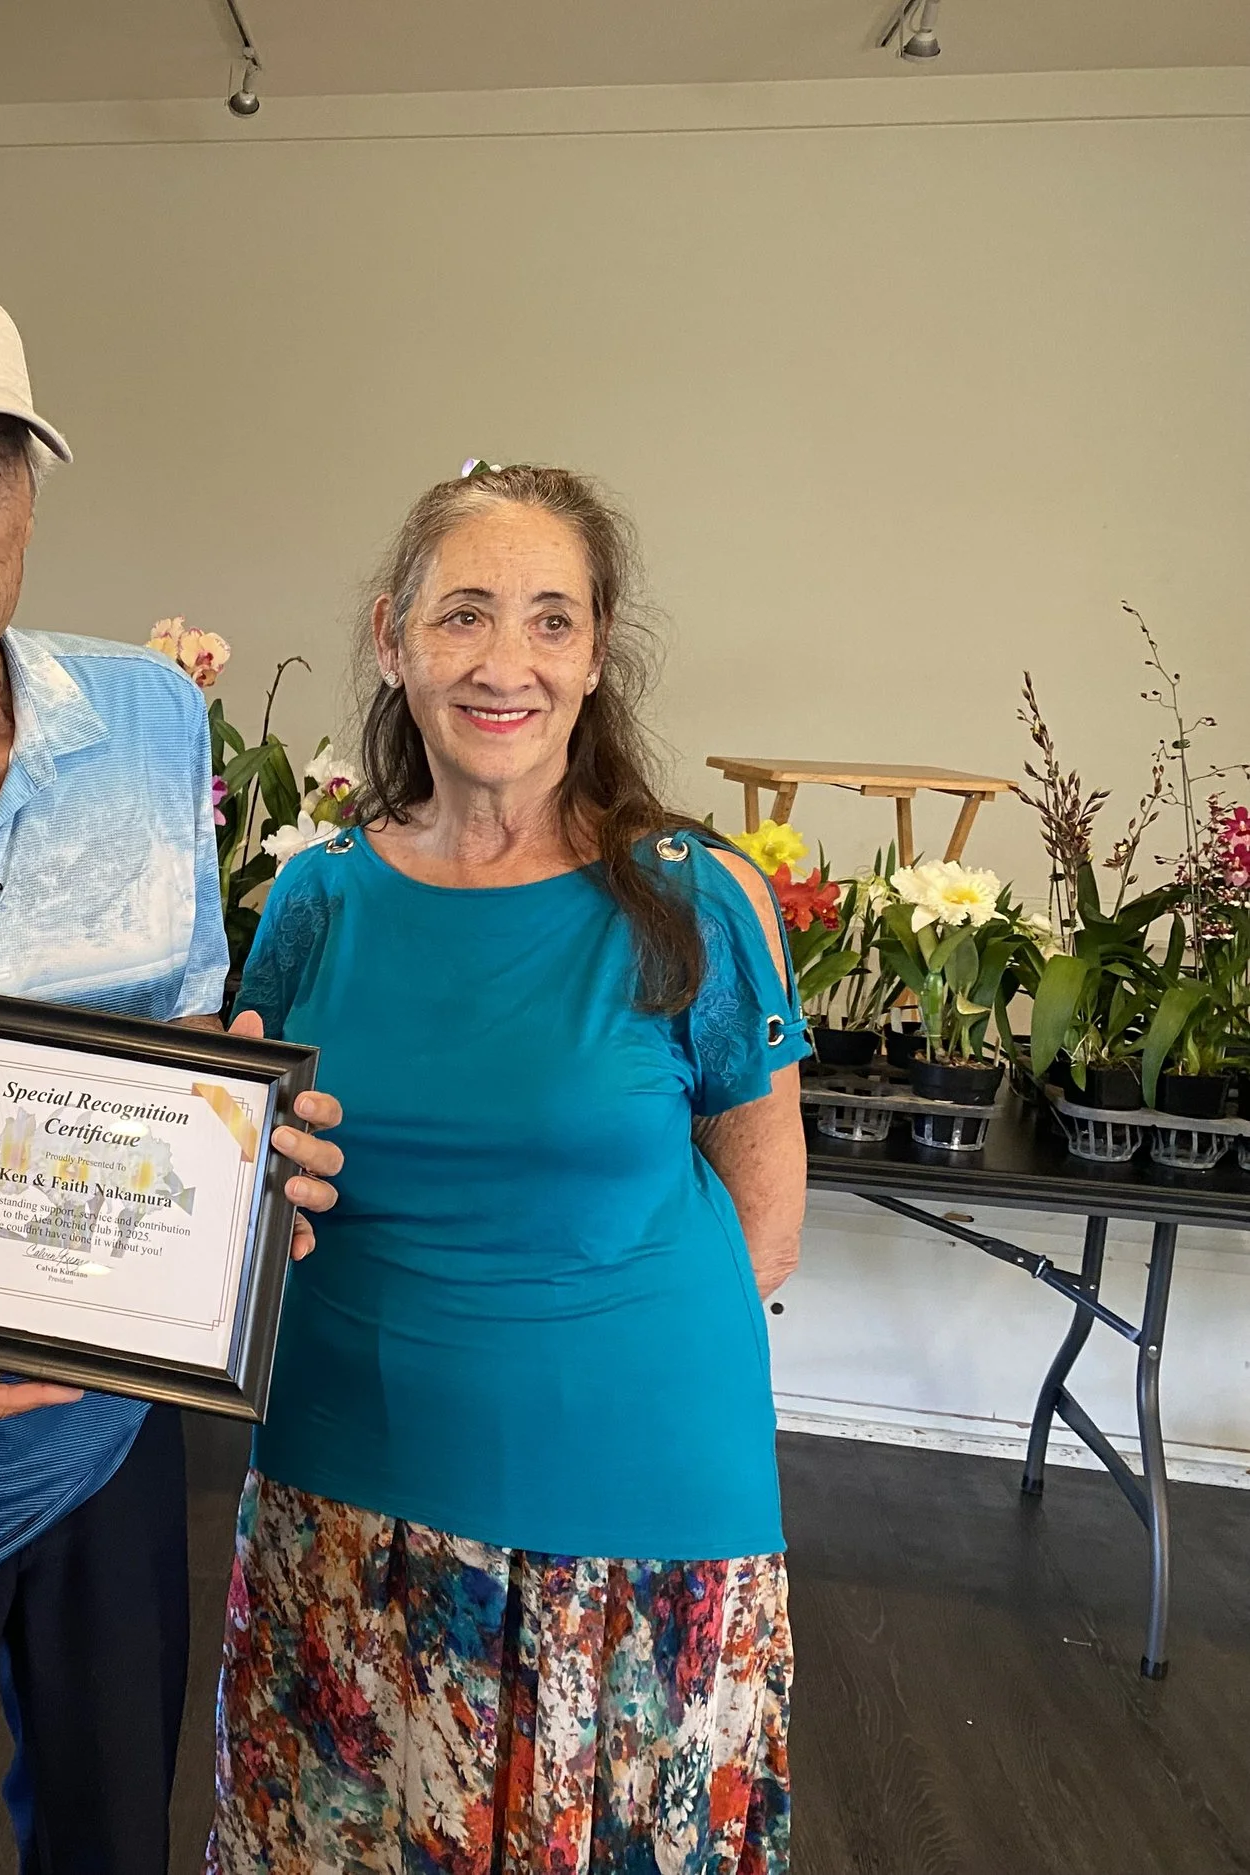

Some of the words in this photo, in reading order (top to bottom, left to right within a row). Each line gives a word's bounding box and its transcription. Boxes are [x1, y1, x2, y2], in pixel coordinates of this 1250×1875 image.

[2, 1081, 73, 1107] Special
[76, 1093, 190, 1126] Recognition
[44, 1117, 141, 1148] Certificate
[45, 1151, 75, 1165] Proudly
[77, 1156, 115, 1170] Presented
[116, 1162, 127, 1172] To
[0, 1167, 28, 1184] Ken
[32, 1173, 46, 1187] &
[51, 1175, 89, 1194] Faith
[94, 1183, 173, 1209] Nakamura
[3, 1209, 13, 1218] to
[14, 1210, 30, 1221] the
[31, 1213, 52, 1226] Aiea
[54, 1217, 87, 1232] Orchid
[89, 1222, 112, 1235] Club
[114, 1226, 123, 1237] in
[125, 1229, 152, 1242] 2025.
[39, 1203, 77, 1217] support,
[79, 1211, 112, 1223] service
[114, 1215, 131, 1227] and
[133, 1220, 191, 1236] contribution
[6, 1221, 43, 1236] couldn't
[45, 1227, 67, 1240] have
[69, 1232, 92, 1244] done
[94, 1235, 101, 1246] it
[104, 1238, 139, 1252] without
[140, 1246, 163, 1257] you!
[35, 1263, 58, 1274] Calvin
[48, 1274, 74, 1285] President
